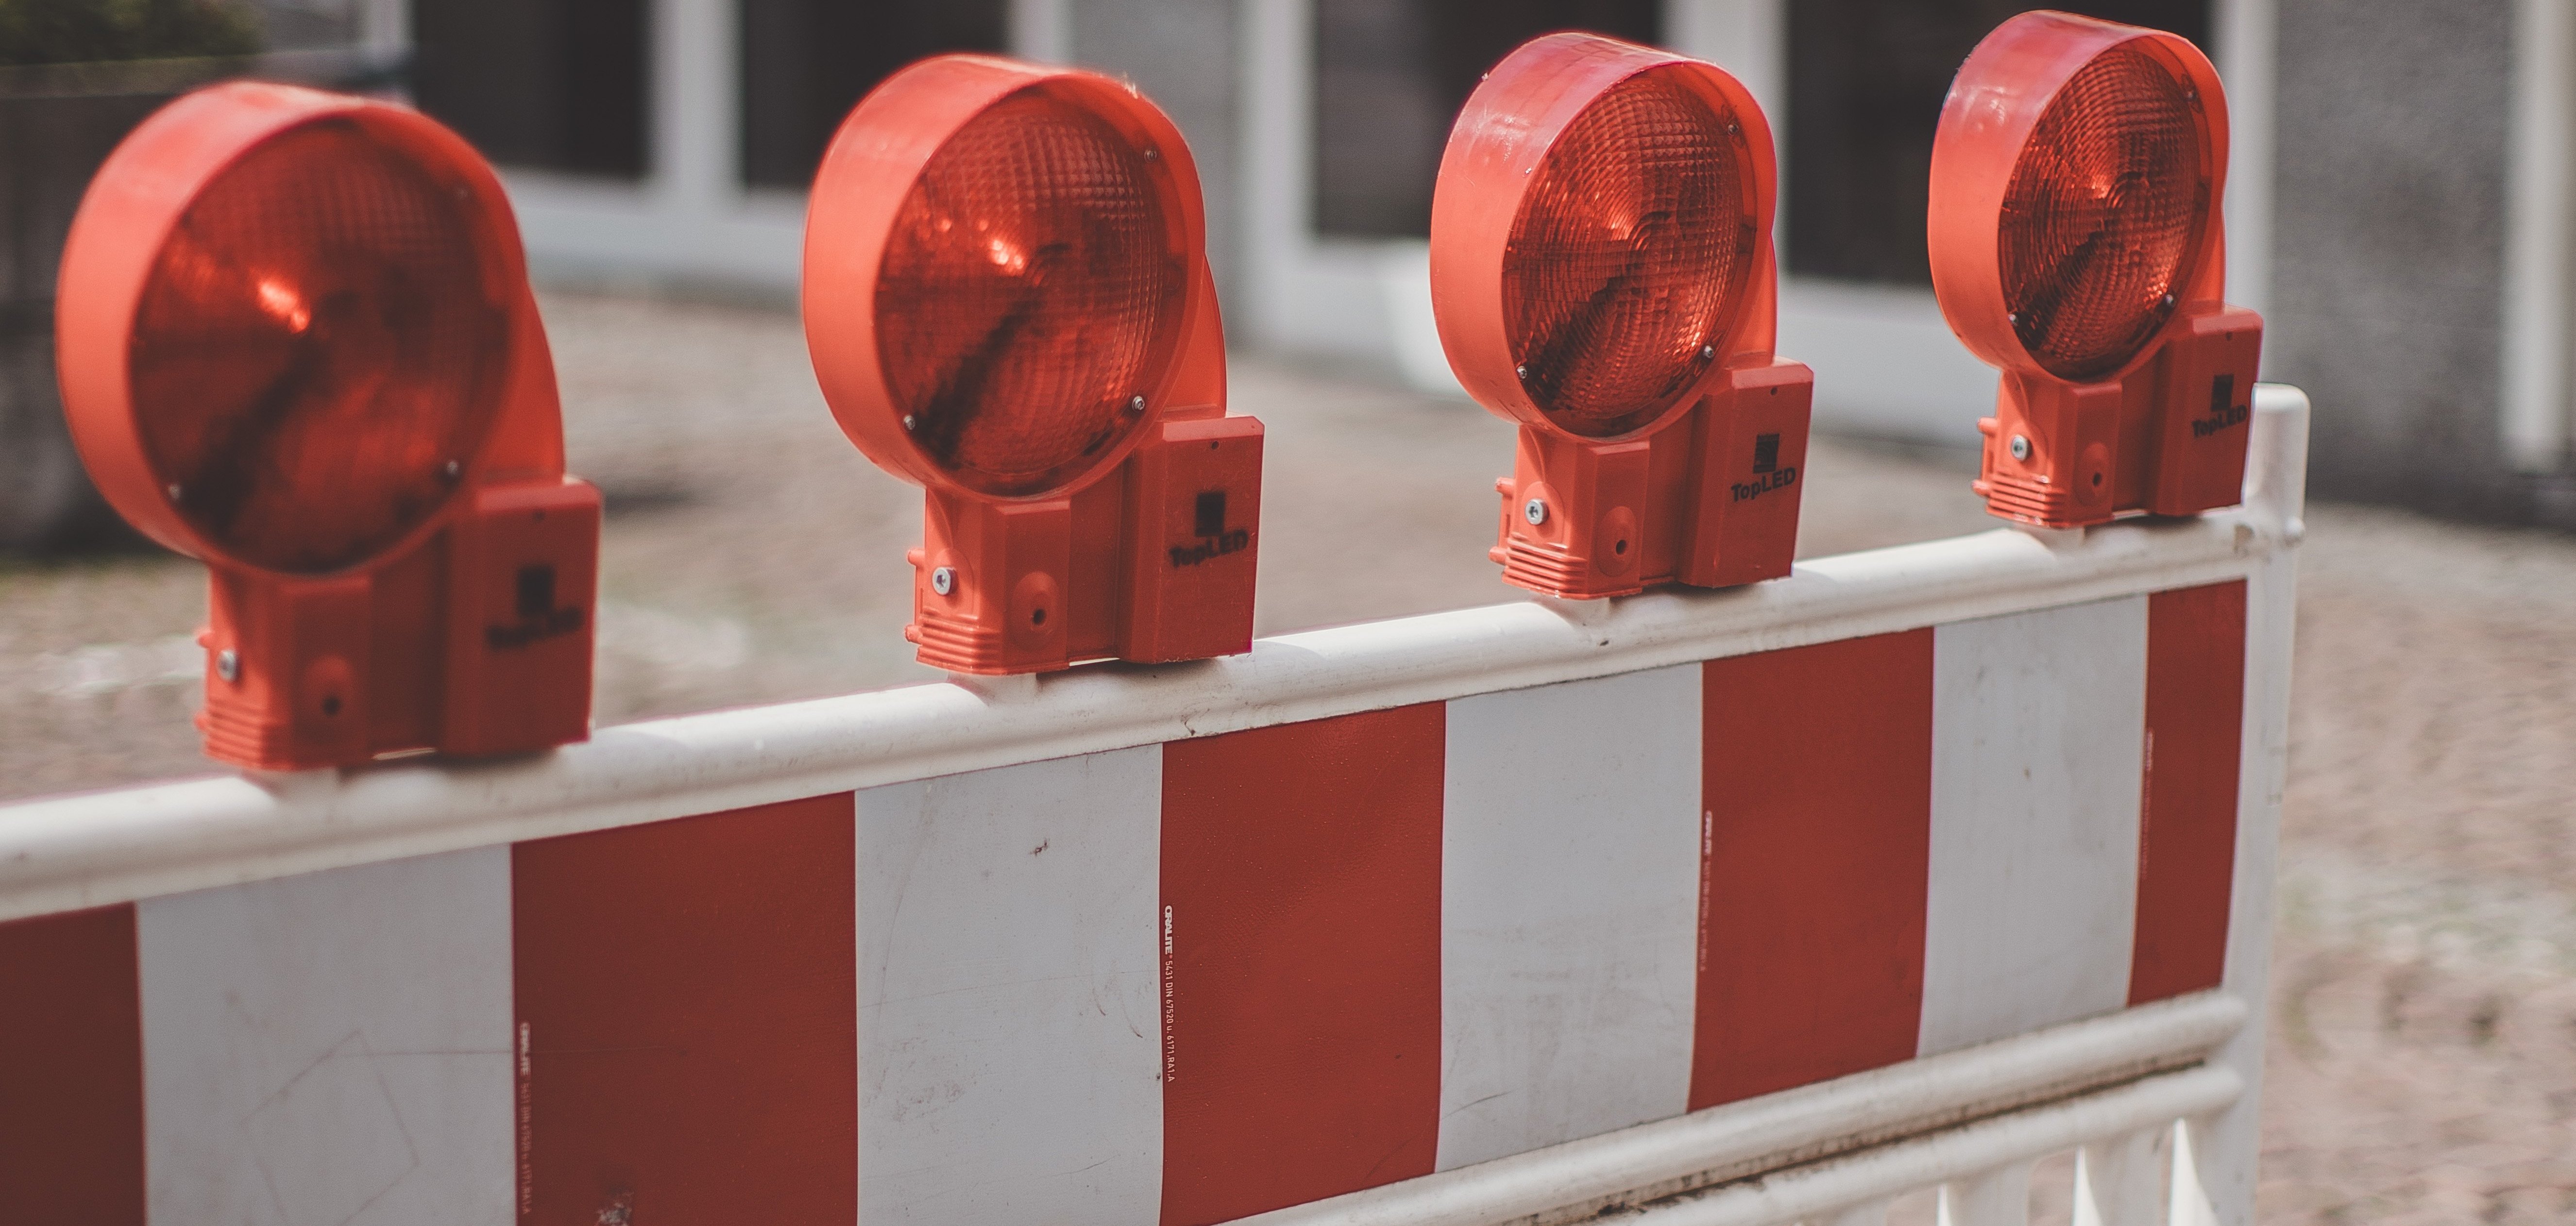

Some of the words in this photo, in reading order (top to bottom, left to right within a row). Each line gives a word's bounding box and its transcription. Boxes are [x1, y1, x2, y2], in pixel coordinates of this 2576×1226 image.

[2192, 404, 2247, 438] TopLED
[1731, 467, 1796, 502] TopLED
[1169, 528, 1249, 568] TopLED
